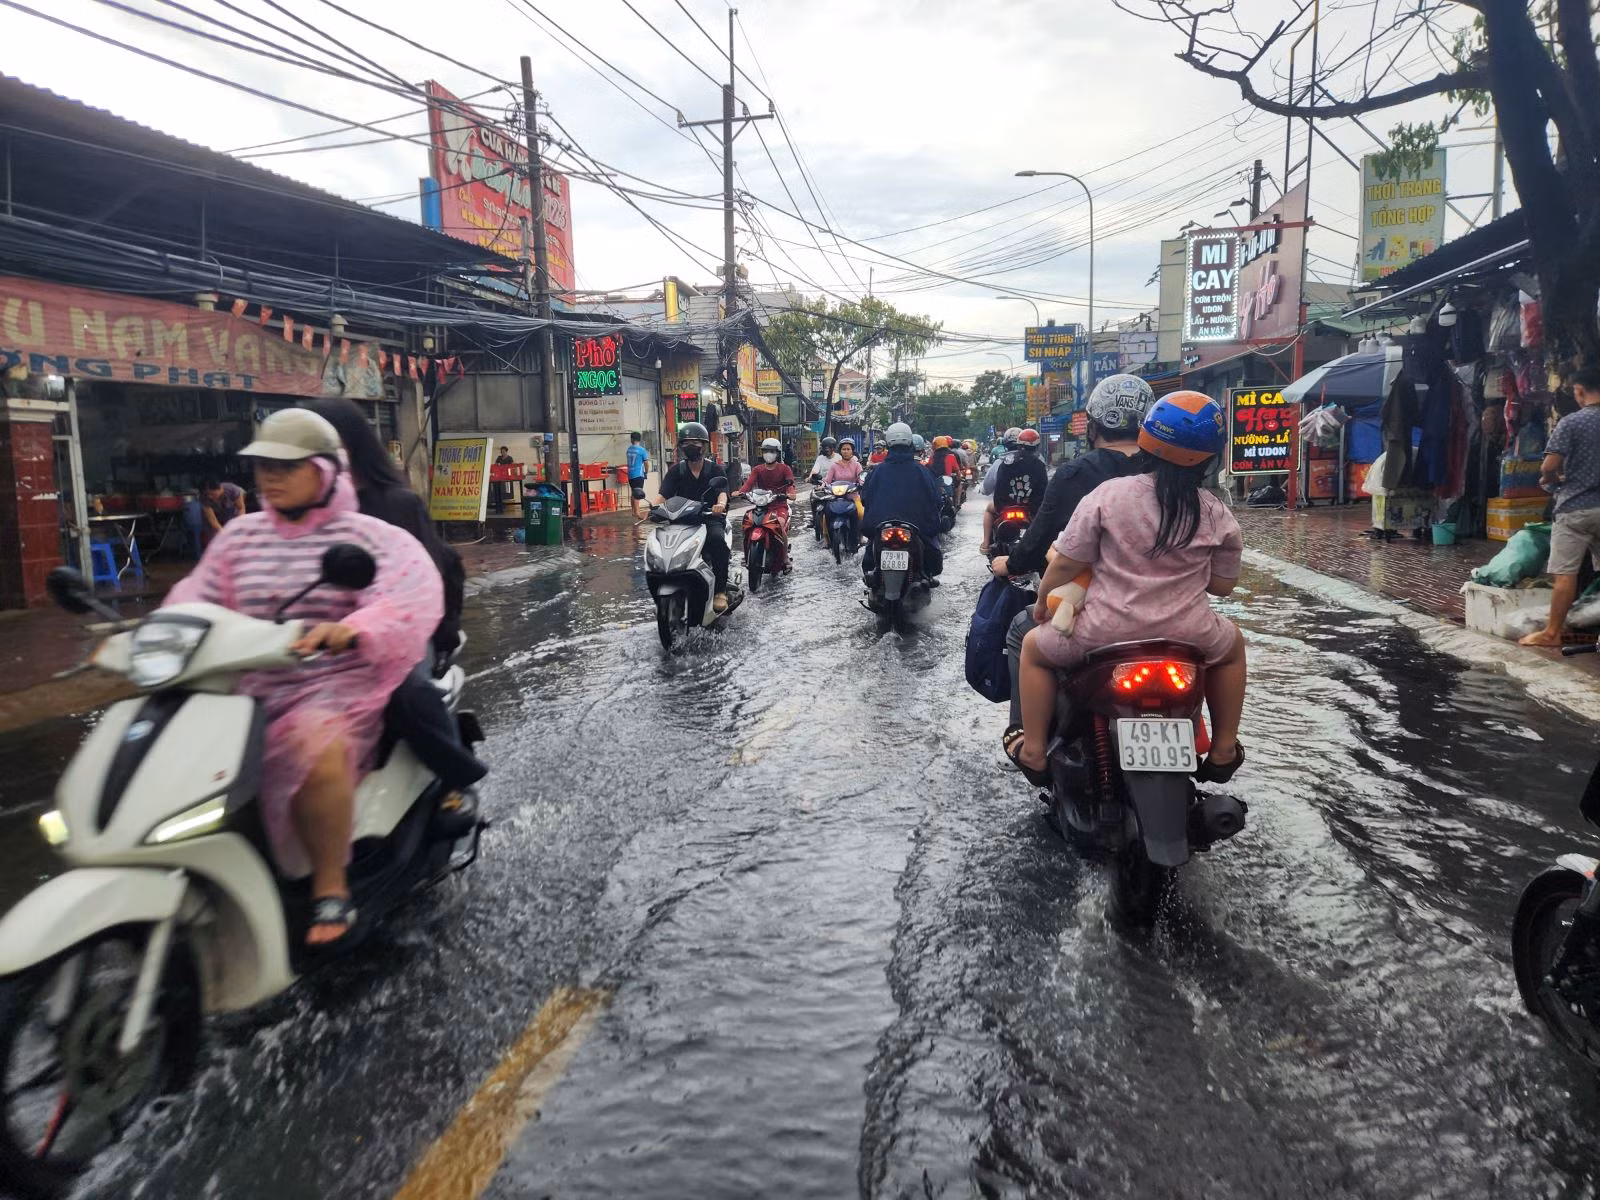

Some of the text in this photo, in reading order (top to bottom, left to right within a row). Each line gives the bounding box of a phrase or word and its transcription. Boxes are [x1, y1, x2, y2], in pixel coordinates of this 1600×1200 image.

[1400, 178, 1440, 198] TRANG
[1371, 203, 1436, 228] TỔNG HỢP
[1201, 240, 1228, 265] MÌ
[1192, 268, 1235, 291] CAY
[1195, 293, 1232, 304] CƠM TRỘN
[1202, 305, 1223, 313] UDON
[69, 307, 189, 360] NAM
[576, 336, 615, 368] Phở
[1094, 355, 1117, 371] TẤN
[577, 370, 617, 391] NGỌC
[1115, 395, 1135, 409] VANS
[1236, 391, 1287, 406] MÌ CA
[1276, 429, 1290, 443] LẨ
[1244, 446, 1287, 457] MÌ UDON
[434, 486, 480, 496] NAM VANG
[1130, 722, 1180, 744] 49-K1
[1124, 745, 1192, 768] 330.95
